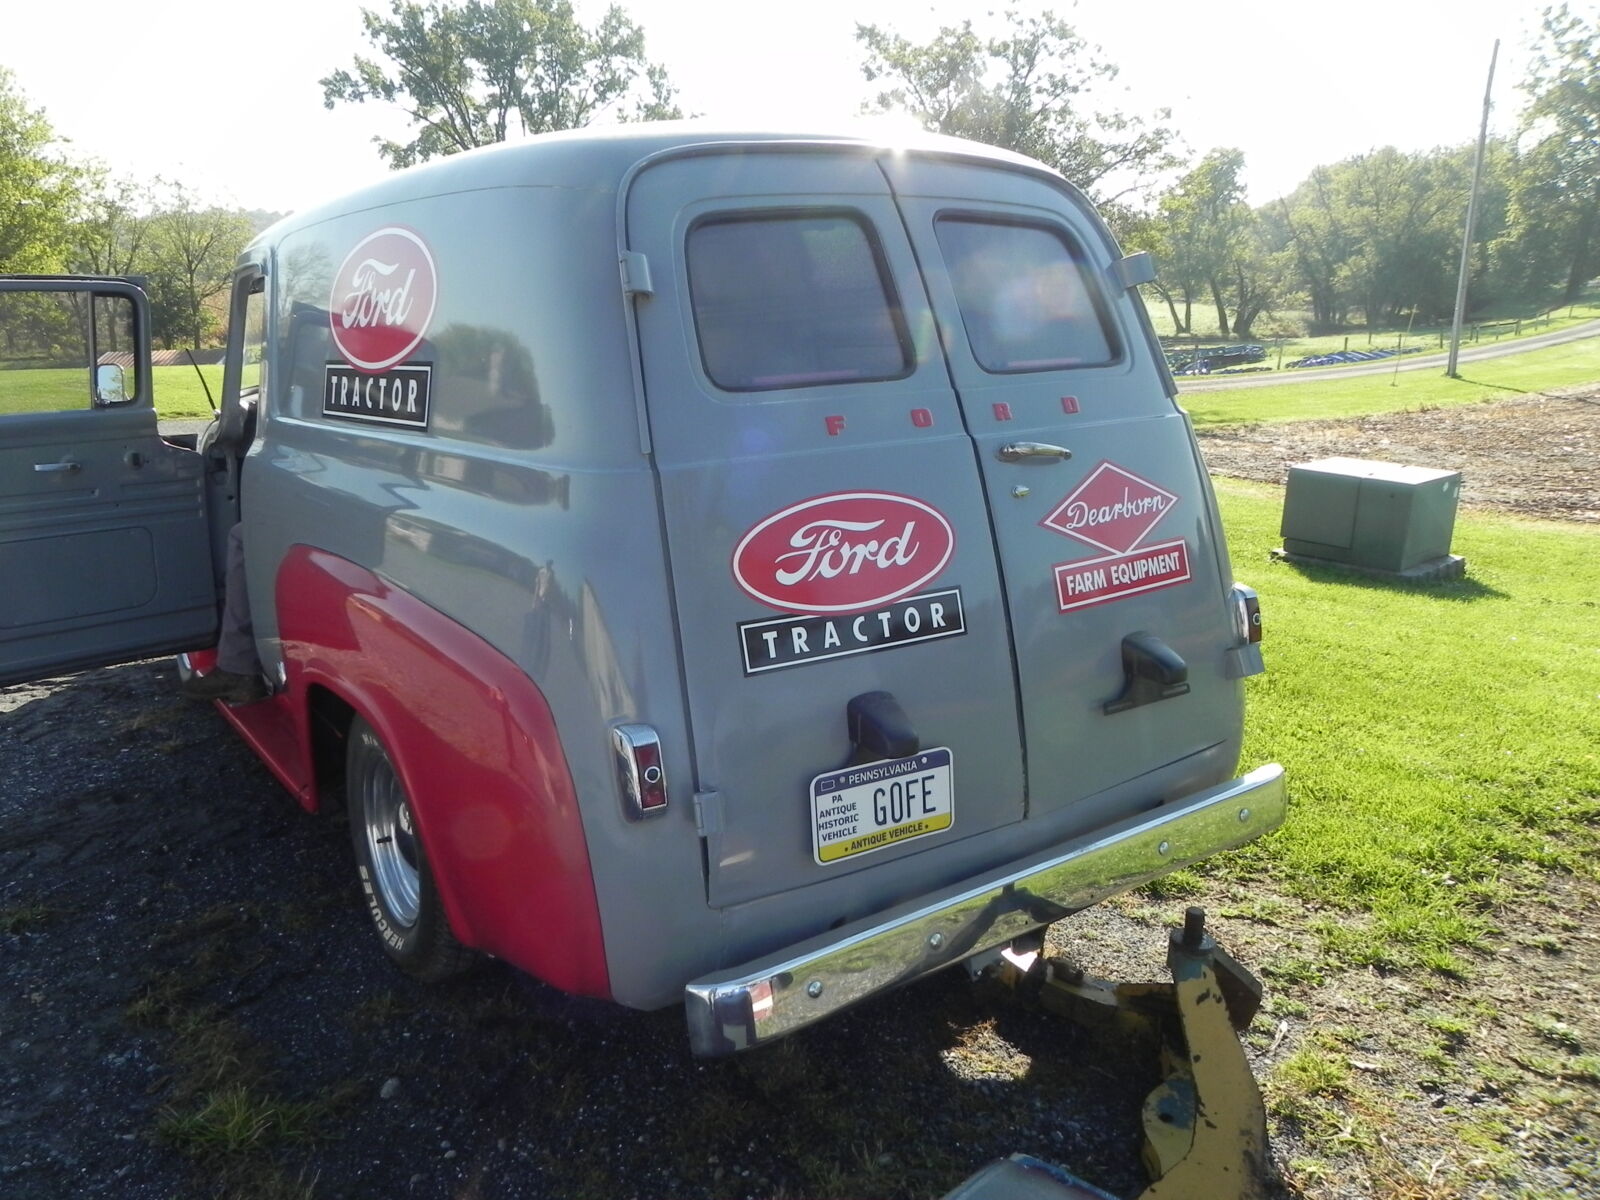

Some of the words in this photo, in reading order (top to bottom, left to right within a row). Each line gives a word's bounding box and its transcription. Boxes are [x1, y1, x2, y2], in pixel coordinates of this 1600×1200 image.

[341, 258, 416, 329] Ford
[331, 375, 418, 413] TRACTOR
[1066, 487, 1166, 529] Dearborn
[775, 519, 919, 586] Ford
[1066, 569, 1107, 596] FARM
[1110, 551, 1180, 585] EQUIPMENT
[762, 602, 946, 659] TRACTOR
[848, 760, 918, 785] PENNSYLVANIA
[819, 802, 857, 819] ANTIQUE
[832, 794, 843, 803] PA
[873, 774, 936, 826] GOFE
[818, 813, 859, 831] HISTORIC
[821, 825, 858, 842] VEHICLE
[851, 832, 887, 850] ANTIQUE
[889, 822, 923, 839] VEHICLE
[359, 865, 405, 950] HERCULES
